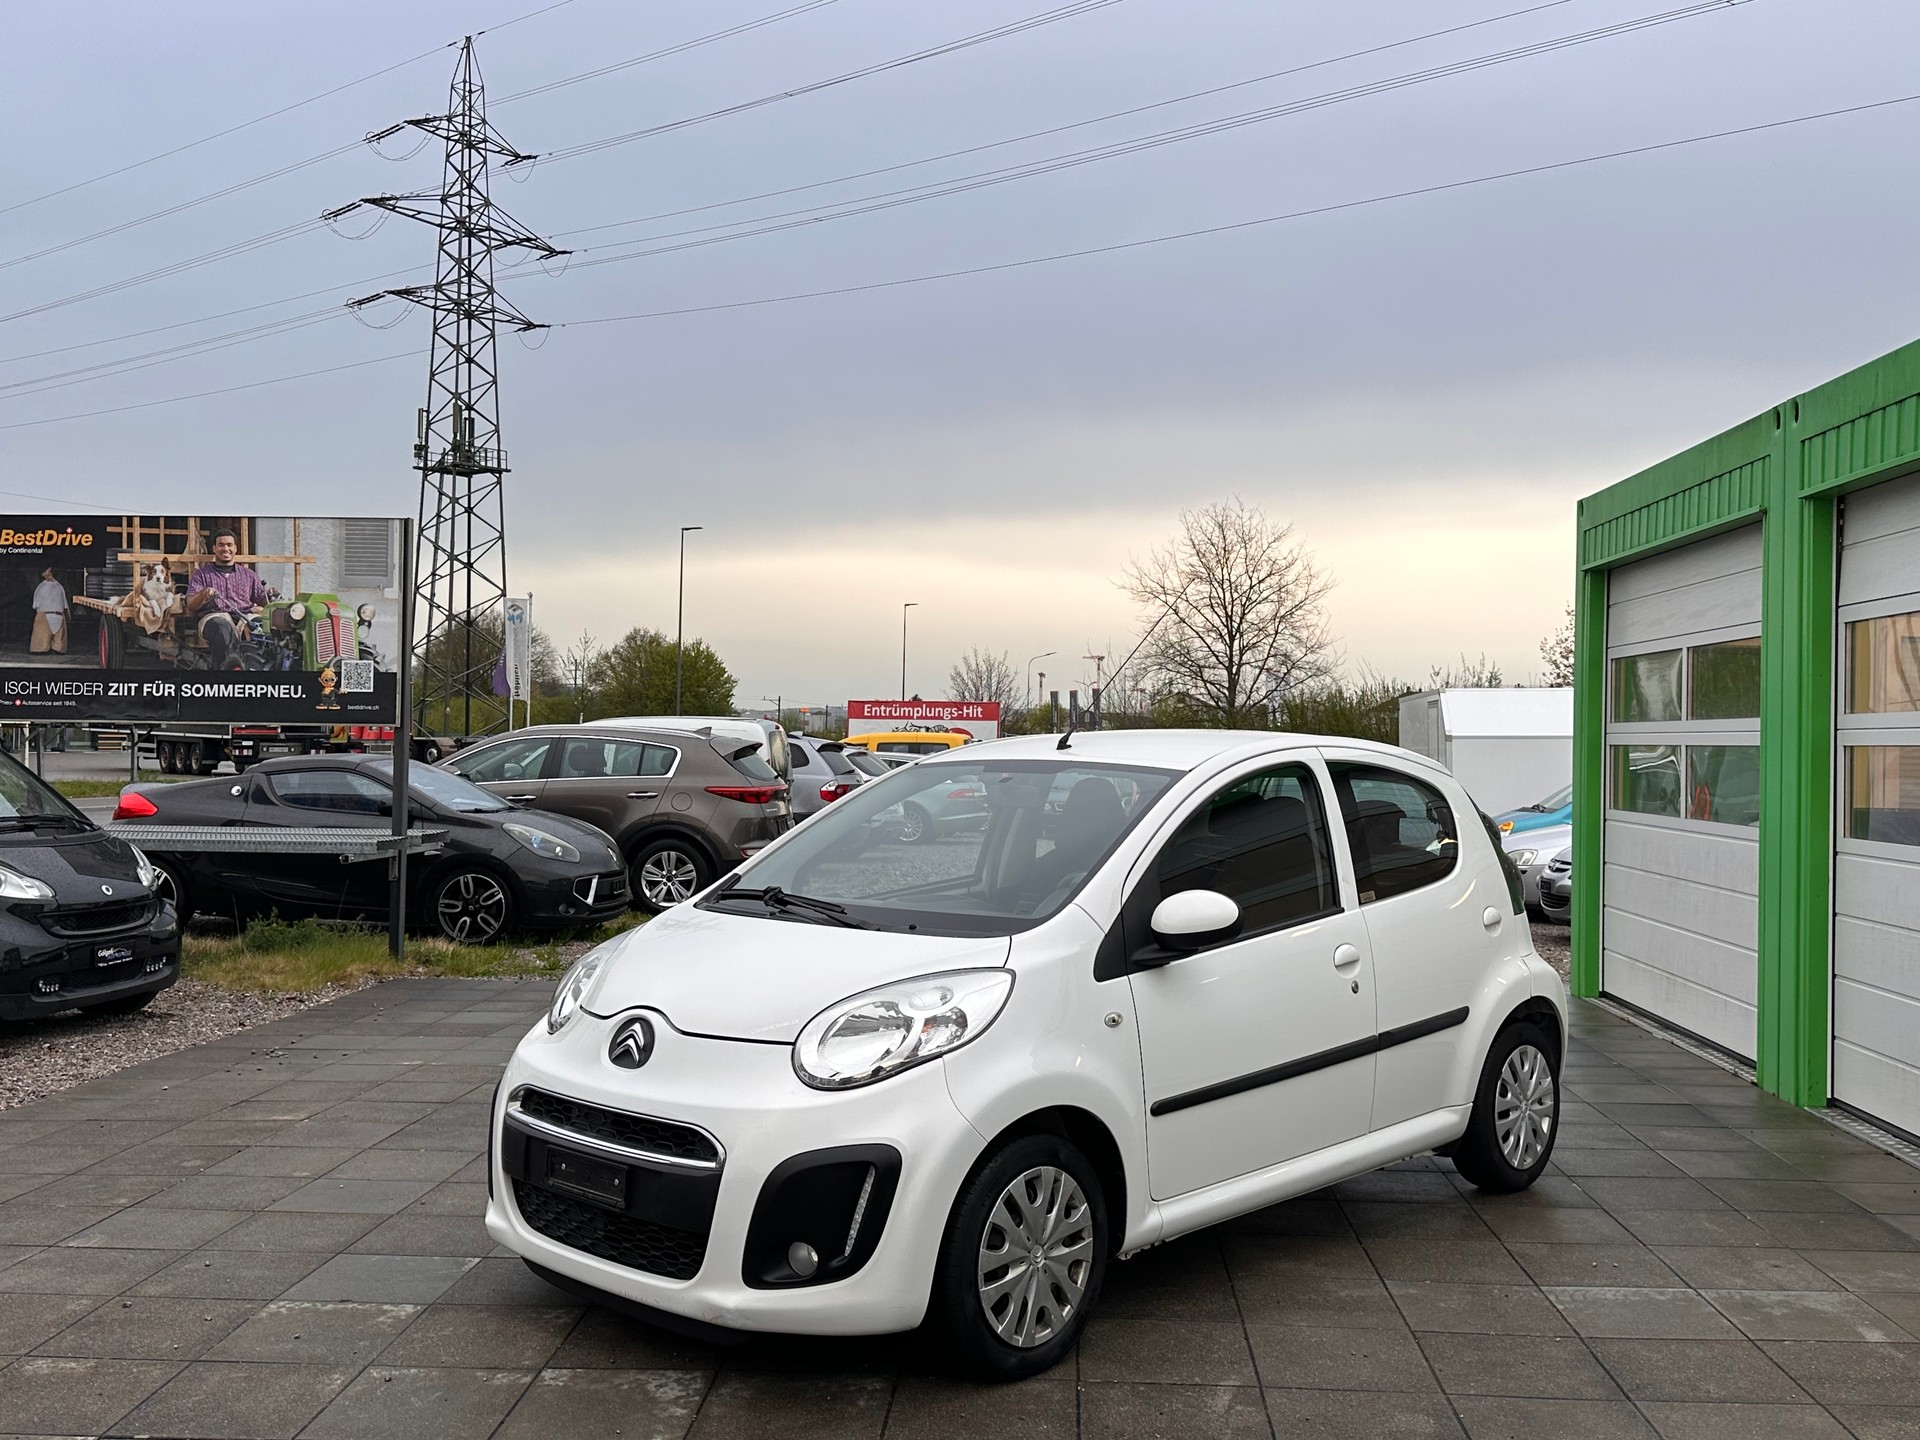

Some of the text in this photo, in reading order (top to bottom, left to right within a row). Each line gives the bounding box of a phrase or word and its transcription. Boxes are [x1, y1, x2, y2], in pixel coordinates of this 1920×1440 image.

[0, 527, 93, 546] BestDrive
[5, 680, 306, 698] ISCH WIEDER ZIIT FÜR SOMMERPNEU.
[864, 704, 983, 720] Entrümplungs-Hit
